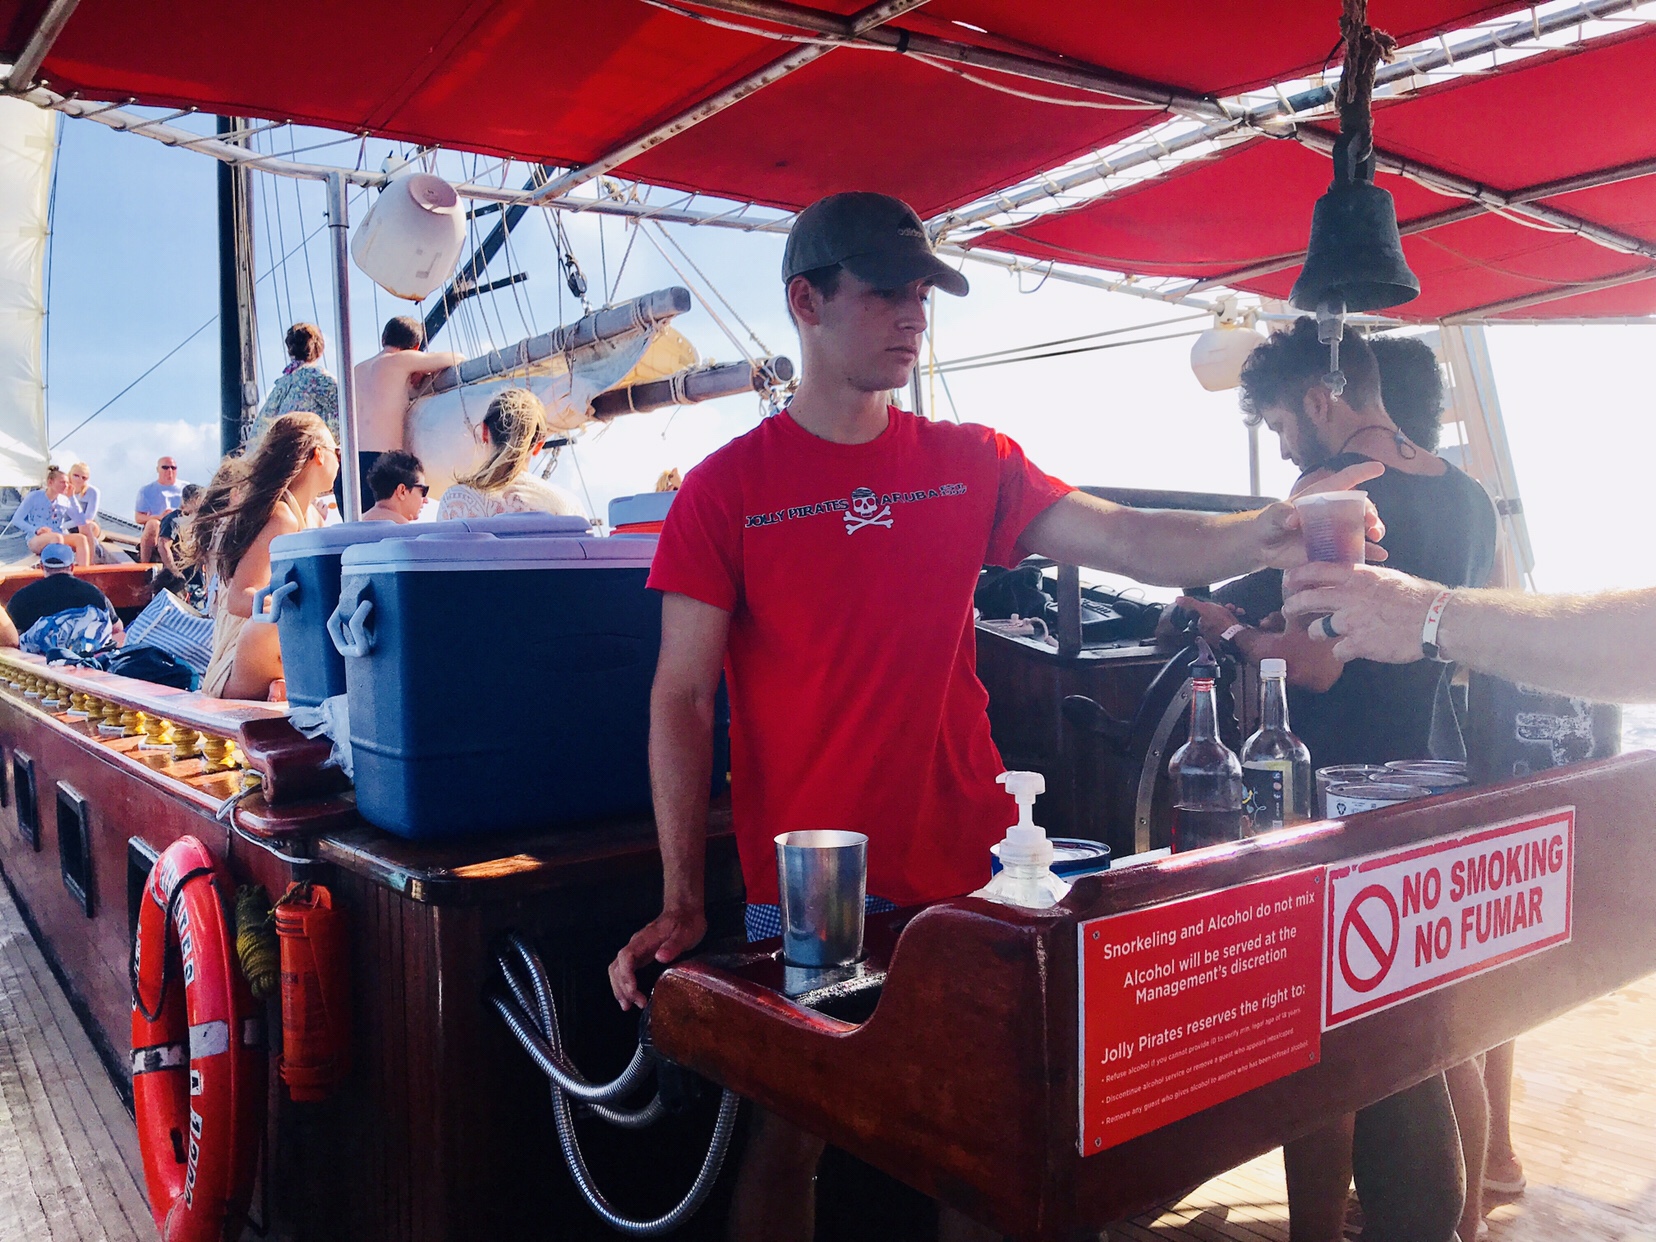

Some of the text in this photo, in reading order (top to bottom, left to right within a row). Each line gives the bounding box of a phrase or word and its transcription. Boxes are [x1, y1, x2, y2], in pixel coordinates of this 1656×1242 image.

[745, 498, 850, 529] JOLLY PIRATES
[881, 490, 939, 506] ARUBA
[1402, 834, 1564, 918] NO SMOKING
[1103, 891, 1315, 960] Snorkeling and Alcohol do not mix
[1123, 926, 1297, 988] Alcohol will be served at the
[1414, 886, 1543, 968] NO FUMAR
[1136, 947, 1287, 1005] Management's discretion
[1101, 984, 1306, 1064] Jolly Pirates reserves the right to:
[1106, 1069, 1127, 1083] Refuse
[1128, 1060, 1150, 1075] alcohol
[1156, 1057, 1167, 1066] you
[1168, 1047, 1188, 1060] cannot
[1188, 1041, 1210, 1054] provide
[1225, 1028, 1239, 1040] verify
[1106, 1085, 1142, 1104] Discontinue
[1143, 1077, 1164, 1090] alcohol
[1165, 1068, 1185, 1082] service
[1193, 1058, 1213, 1071] remove
[1219, 1050, 1234, 1062] guest
[1234, 1046, 1246, 1055] who
[1246, 1039, 1266, 1051] appears
[1106, 1110, 1131, 1125] Remove
[1131, 1105, 1142, 1115] any
[1143, 1098, 1160, 1111] guest
[1161, 1094, 1173, 1103] who
[1174, 1088, 1189, 1100] gives
[1190, 1079, 1210, 1092] alcohol
[1217, 1069, 1237, 1081] anyone
[1237, 1064, 1249, 1073] who
[1249, 1060, 1258, 1069] has
[1258, 1054, 1272, 1065] been
[1271, 1047, 1290, 1060] refused
